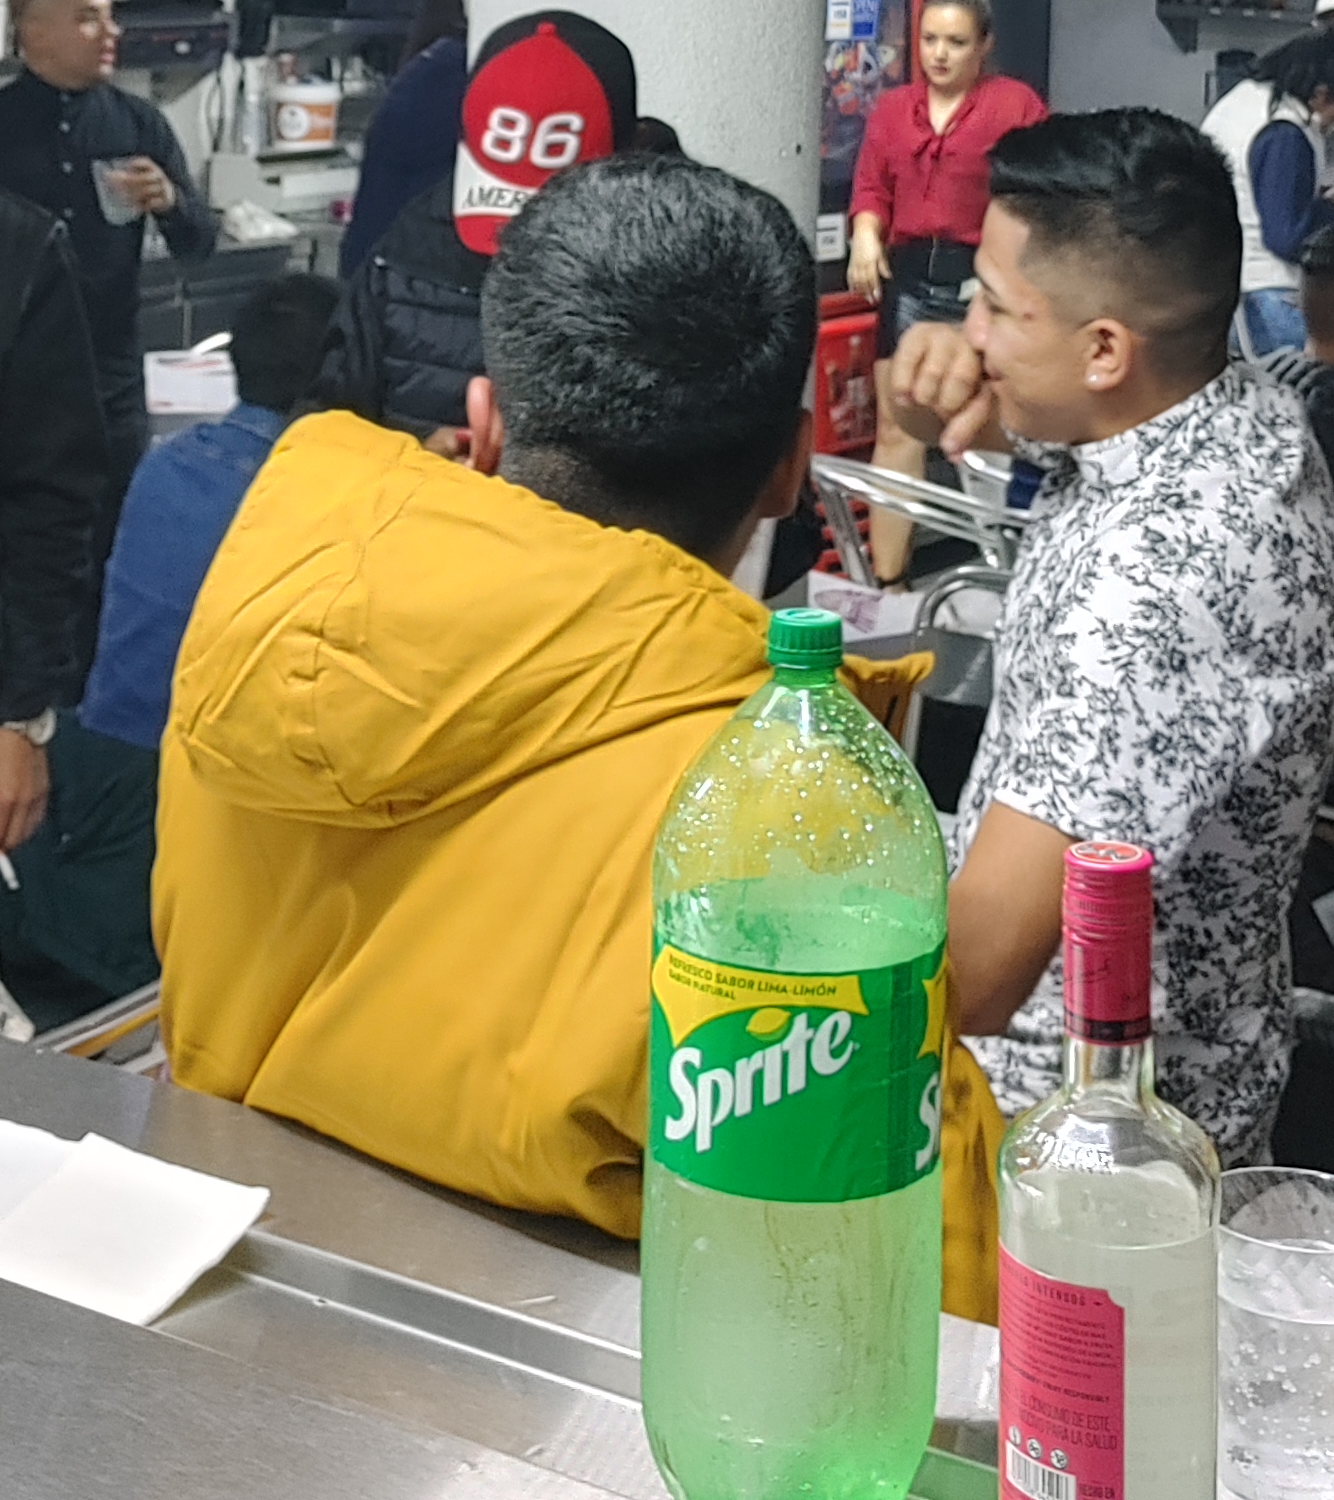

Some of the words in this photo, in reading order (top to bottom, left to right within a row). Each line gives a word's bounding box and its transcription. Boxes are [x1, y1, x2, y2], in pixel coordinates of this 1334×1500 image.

[481, 106, 584, 170] 86
[669, 953, 713, 981] REFRESCO
[715, 972, 755, 991] SABOR
[693, 980, 735, 1000] NATURAL
[664, 1010, 854, 1153] Sprite
[1032, 1280, 1086, 1307] INTENSOS
[1028, 1394, 1070, 1425] CONSUMO
[1072, 1410, 1086, 1428] DE
[1087, 1414, 1111, 1432] ESTE
[1070, 1427, 1084, 1445] LA
[1085, 1431, 1118, 1450] SALUD
